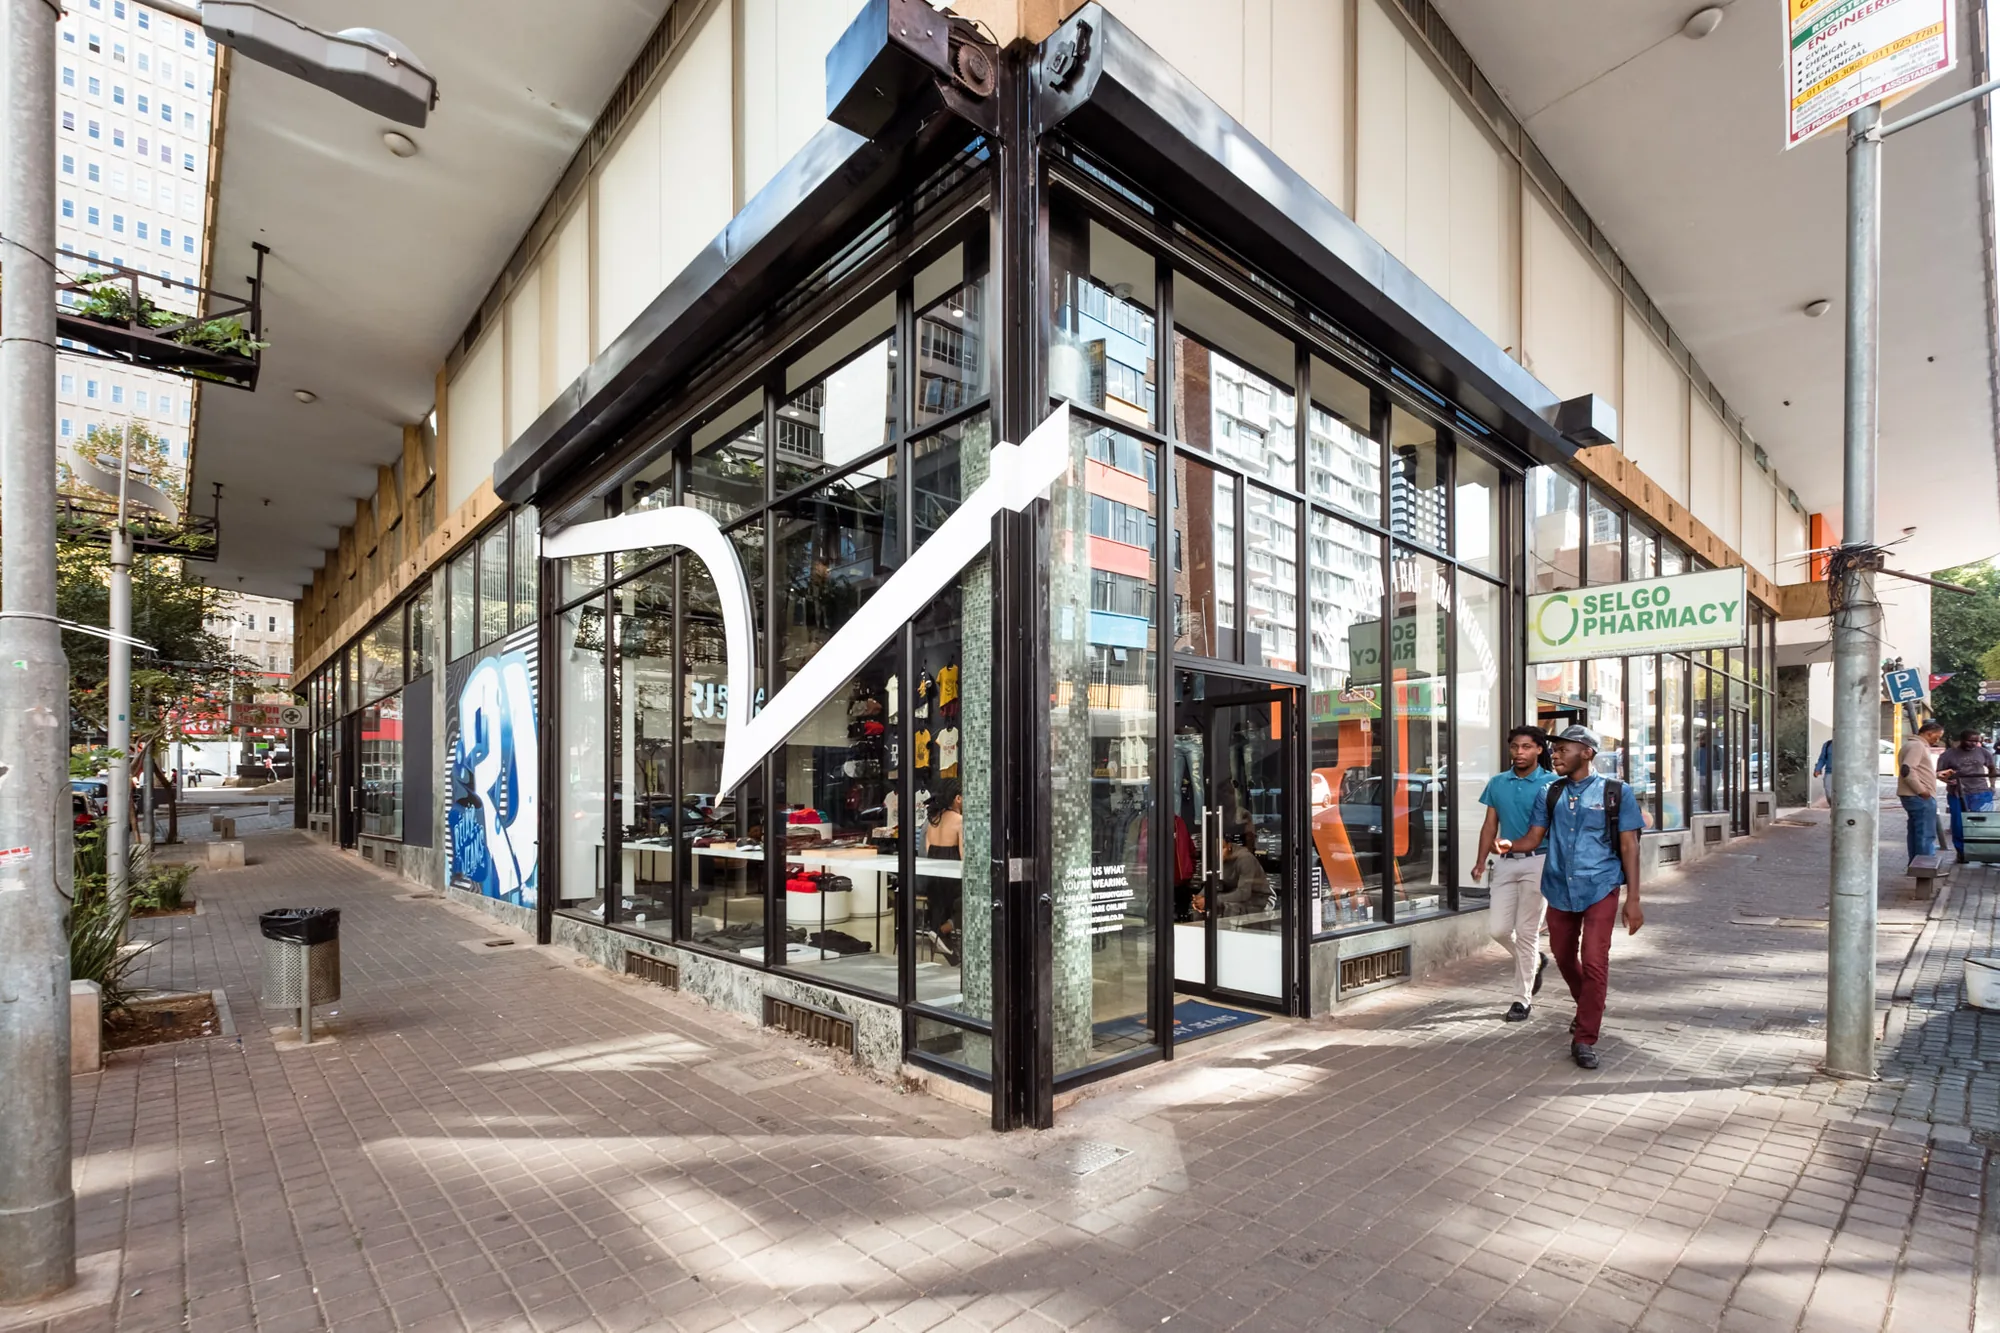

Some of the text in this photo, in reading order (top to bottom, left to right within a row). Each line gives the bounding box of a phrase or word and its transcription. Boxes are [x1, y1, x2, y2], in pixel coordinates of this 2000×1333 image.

[1805, 44, 1828, 61] CIVIL
[1805, 40, 1847, 70] CHEMICAL
[1806, 41, 1863, 79] ELECTRICAL
[1806, 49, 1867, 87] MECHANICAL
[1806, 85, 1821, 98] 011
[1823, 73, 1839, 86] 403
[1798, 126, 1812, 138] GET
[1812, 100, 1857, 129] PRACTICALS
[1885, 64, 1938, 91] ASSISTANCE
[1583, 586, 1671, 615] SELGO
[1583, 600, 1739, 637] PHARMACY
[1894, 672, 1910, 688] P
[1062, 877, 1128, 891] YOU'RE WEARING.
[1065, 864, 1125, 878] SHOW US WHAT
[1188, 1014, 1239, 1029] JEANS
